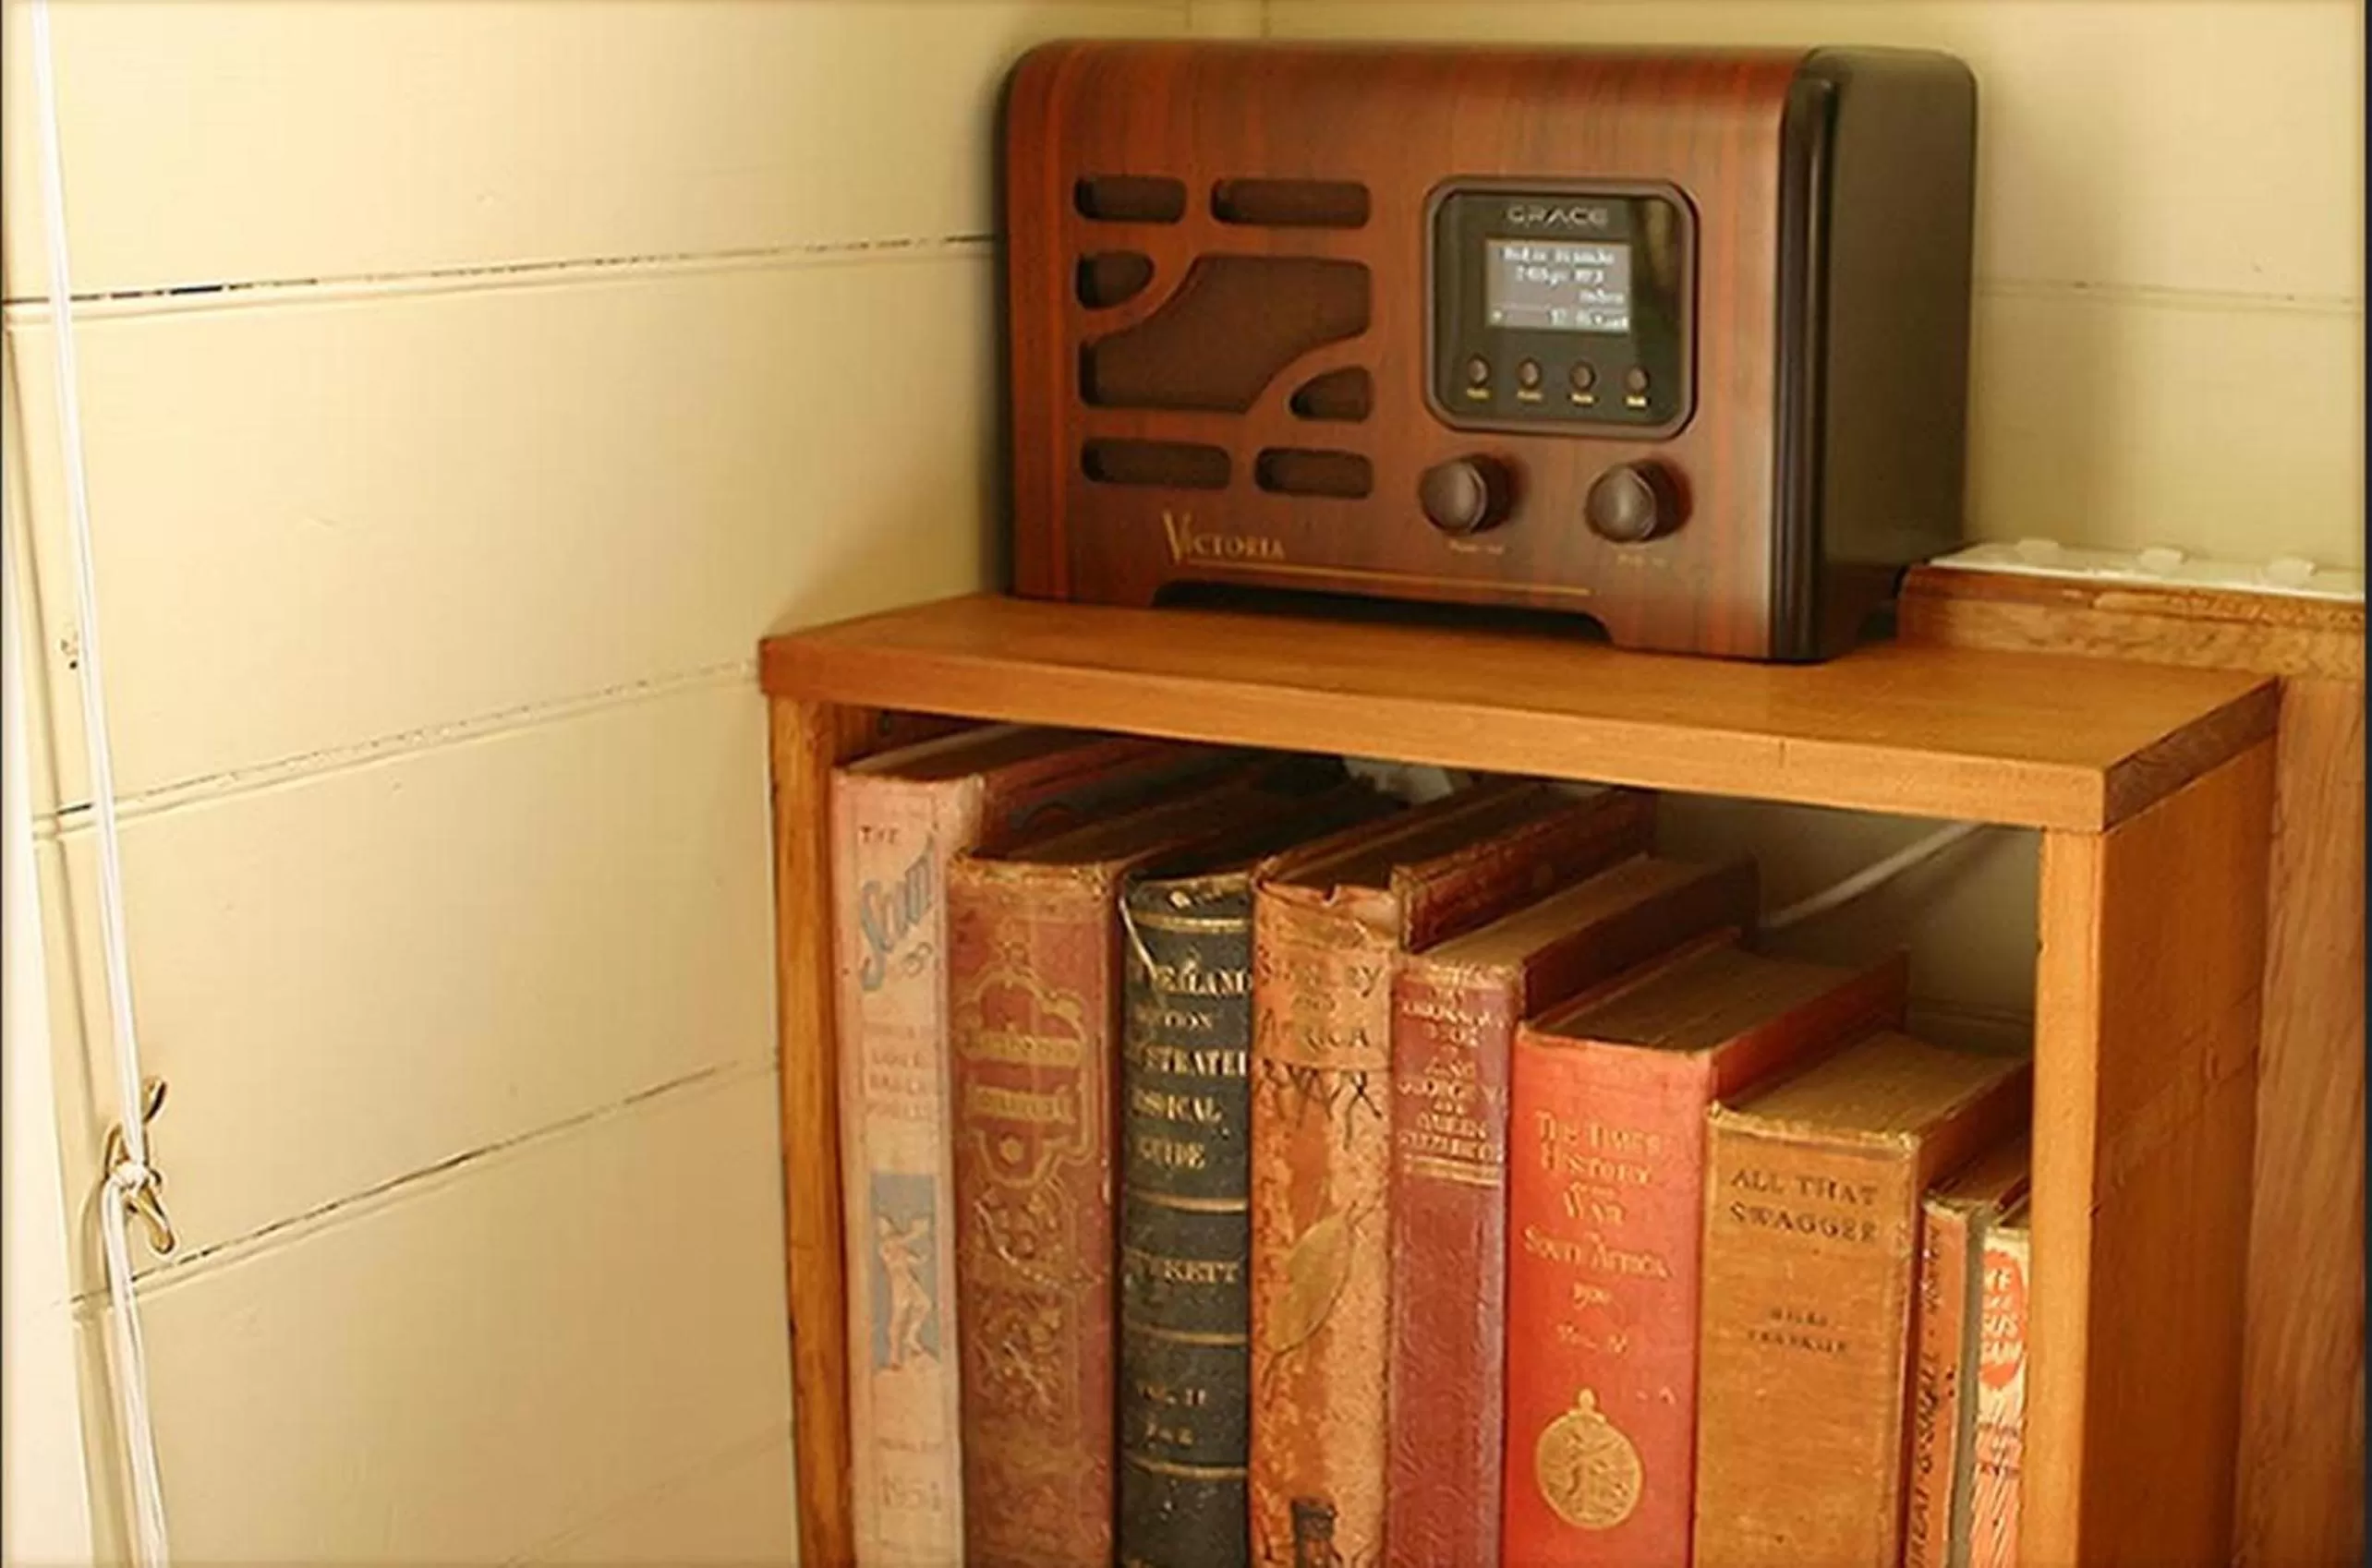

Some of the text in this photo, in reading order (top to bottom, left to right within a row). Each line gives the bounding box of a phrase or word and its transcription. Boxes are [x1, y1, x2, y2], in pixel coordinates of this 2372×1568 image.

[1506, 205, 1609, 228] GRACE
[1162, 510, 1286, 564] VICTORIA
[1730, 1167, 1879, 1207] ALL THAT
[1730, 1200, 1877, 1243] SWAGGER
